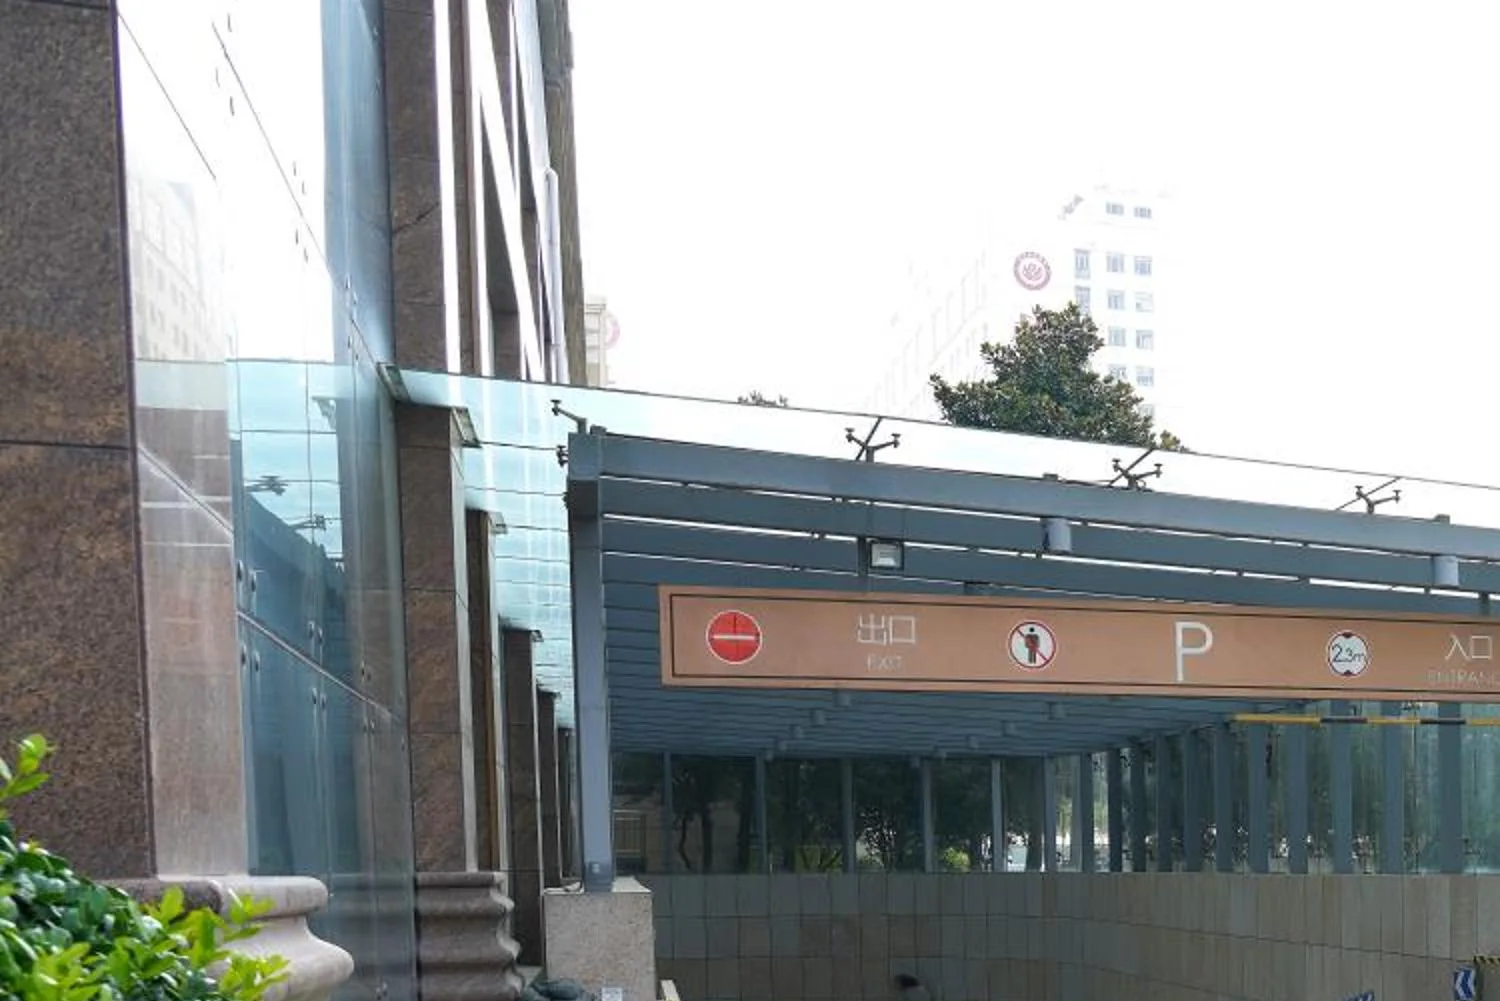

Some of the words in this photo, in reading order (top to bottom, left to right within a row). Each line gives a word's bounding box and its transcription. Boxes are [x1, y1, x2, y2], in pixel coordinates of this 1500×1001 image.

[857, 613, 916, 645] 出口
[1175, 621, 1213, 682] P
[1445, 634, 1493, 660] 入口
